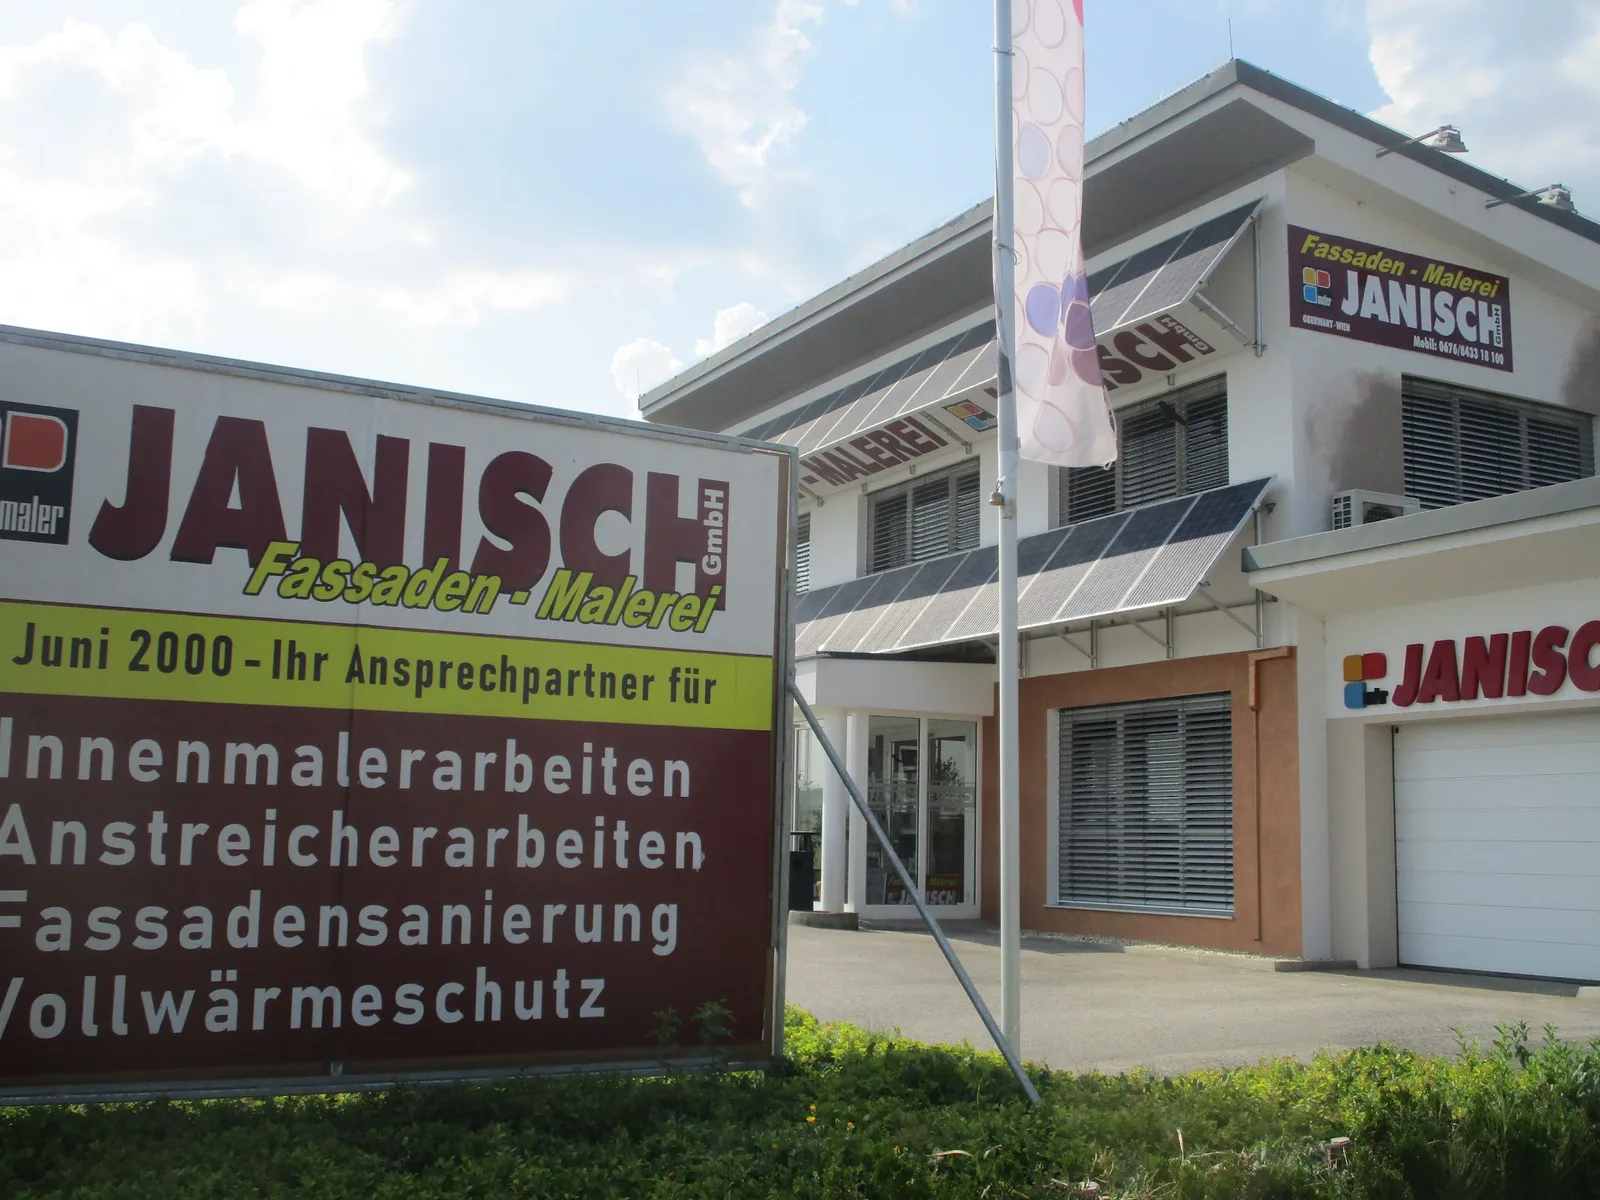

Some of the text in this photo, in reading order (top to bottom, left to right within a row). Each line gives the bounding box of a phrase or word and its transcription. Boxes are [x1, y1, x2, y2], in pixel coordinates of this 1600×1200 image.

[1301, 234, 1405, 276] Fassaden
[1422, 262, 1500, 298] Malerei
[1160, 317, 1210, 352] GmbH
[1341, 270, 1504, 348] JANISCH
[1494, 307, 1502, 344] GmbH
[1413, 335, 1438, 351] Mobil:
[1481, 349, 1490, 362] 18
[1491, 351, 1504, 365] 100
[800, 416, 949, 487] MALEREI
[0, 495, 65, 535] maler
[88, 404, 730, 611] JANISCH
[701, 488, 725, 576] GmbH
[242, 539, 502, 614] Fassaden
[535, 567, 722, 633] Malerei
[12, 622, 110, 669] Juni
[128, 629, 234, 677] 2000
[271, 638, 329, 682] Ihr
[344, 643, 656, 705] Ansprechpartner
[668, 666, 717, 705] für
[0, 716, 690, 798] Innenmalerarbeiten
[0, 803, 703, 870] Anstreicherarbeiten
